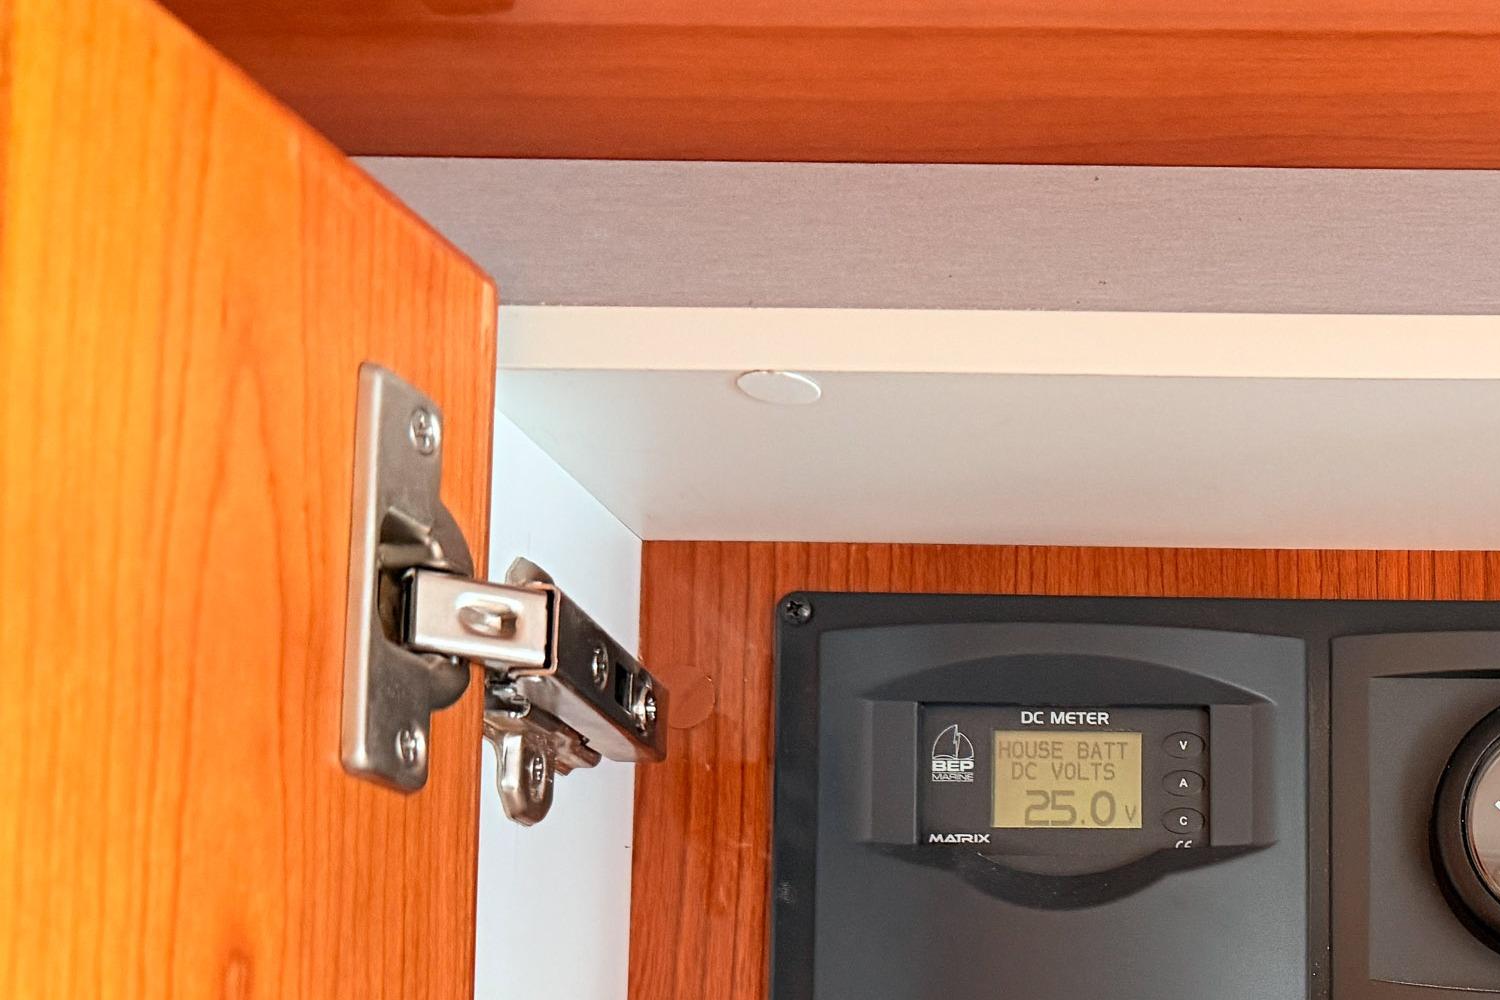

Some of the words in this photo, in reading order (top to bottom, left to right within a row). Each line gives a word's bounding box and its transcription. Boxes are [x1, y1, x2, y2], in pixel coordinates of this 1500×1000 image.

[1021, 711, 1044, 725] DC
[1050, 711, 1110, 725] METER
[999, 741, 1063, 759] HOUSE
[1077, 742, 1128, 760] BATT
[1179, 741, 1188, 750] V
[932, 760, 974, 772] BEP
[1012, 762, 1037, 780] DC
[1051, 763, 1116, 781] VOLTS
[932, 772, 974, 782] MARINE
[1179, 778, 1188, 788] A
[1024, 790, 1116, 827] 25.0
[1179, 816, 1188, 826] C
[928, 833, 991, 843] MATRIX
